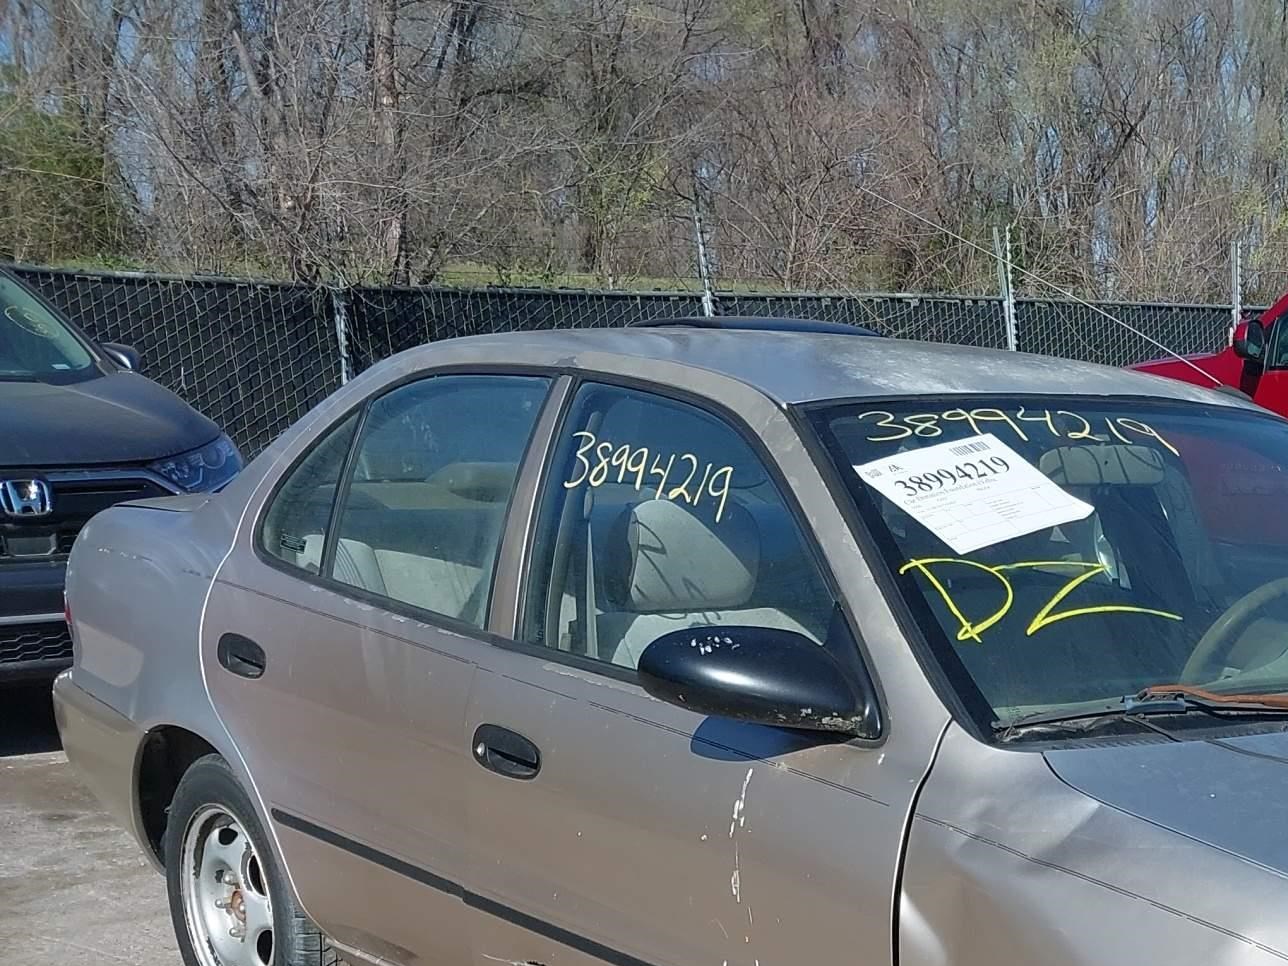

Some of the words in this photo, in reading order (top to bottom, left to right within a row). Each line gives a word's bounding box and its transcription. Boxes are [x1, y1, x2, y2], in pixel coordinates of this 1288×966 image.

[857, 405, 1180, 457] 38994219
[563, 431, 734, 523] 38994219
[894, 456, 1010, 497] 38994219
